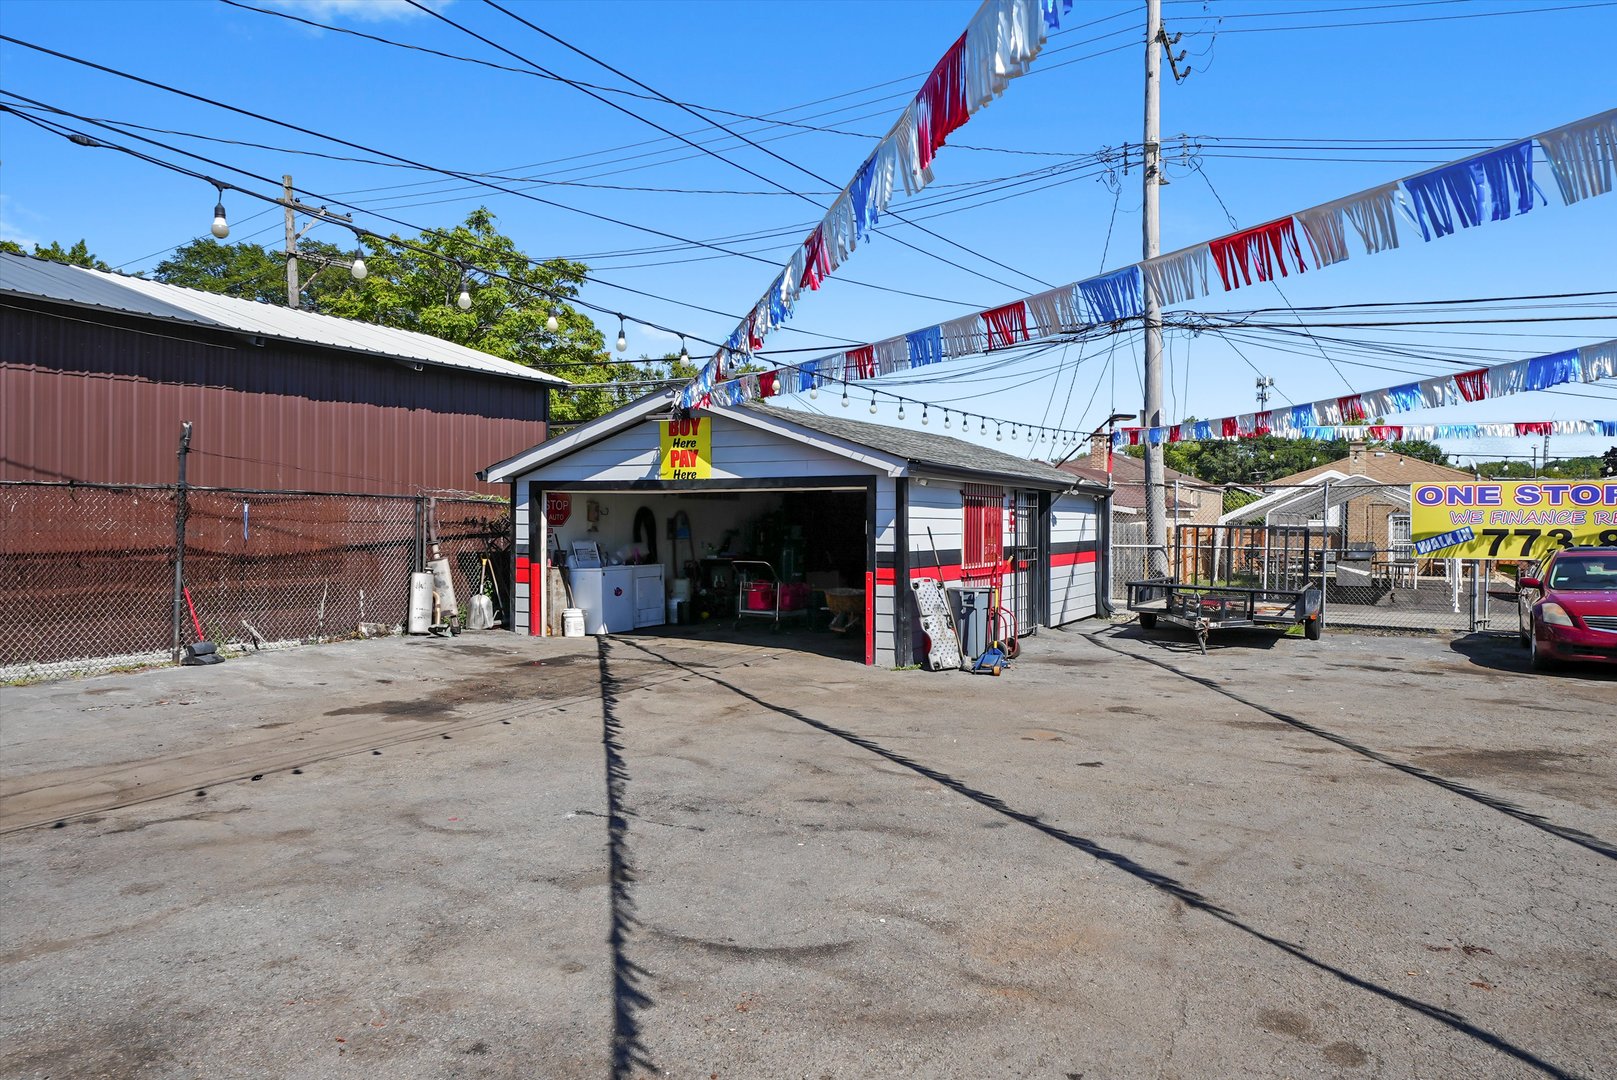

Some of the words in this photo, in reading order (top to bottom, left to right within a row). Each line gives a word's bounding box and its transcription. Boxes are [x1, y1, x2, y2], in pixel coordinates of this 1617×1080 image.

[669, 418, 701, 437] BUY
[673, 438, 697, 448] Here
[670, 449, 699, 468] PAY
[673, 469, 697, 480] Here
[1415, 484, 1502, 506] ONE
[546, 500, 569, 511] STOP
[548, 513, 564, 521] AUTO
[1449, 509, 1484, 525] WE
[1490, 509, 1587, 525] FINANCE
[1594, 509, 1617, 525] R
[1417, 532, 1456, 554] WALK
[1455, 527, 1474, 541] IN
